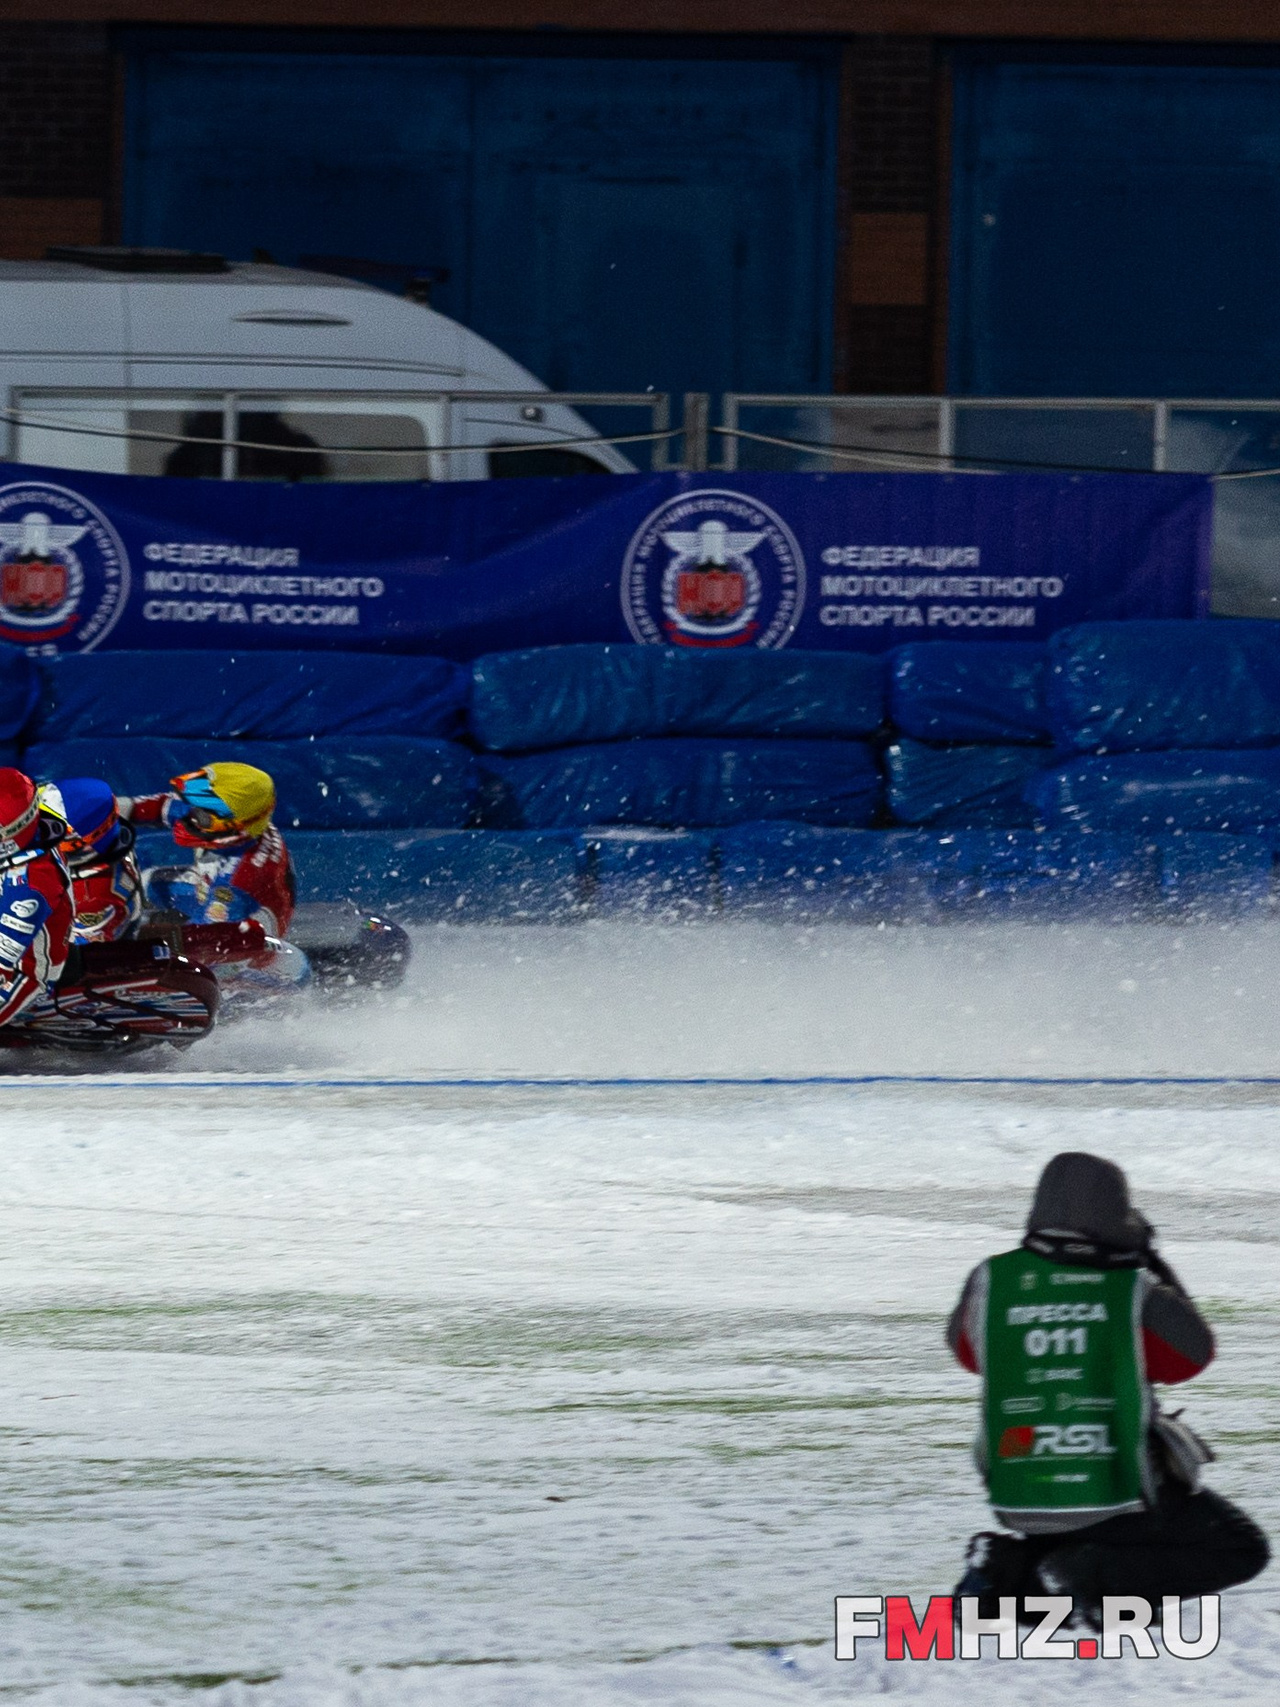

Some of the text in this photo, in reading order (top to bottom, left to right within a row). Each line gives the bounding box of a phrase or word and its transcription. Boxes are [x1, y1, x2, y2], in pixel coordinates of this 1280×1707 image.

[143, 543, 300, 569] ФЕДЕРАЦИЯ
[821, 545, 980, 571] ФЕДЕРАЦИЯ
[144, 570, 385, 597] МОТОЦИКЛЕТНОГО
[821, 575, 1064, 600] МОТОЦИКЛЕТНОГО
[142, 600, 360, 626] СПОРТА РОССИИ
[819, 604, 1036, 627] СПОРТА РОССИИ
[1006, 1302, 1109, 1326] ПРЕССА
[1023, 1326, 1088, 1357] 011
[1031, 1424, 1118, 1456] RSL
